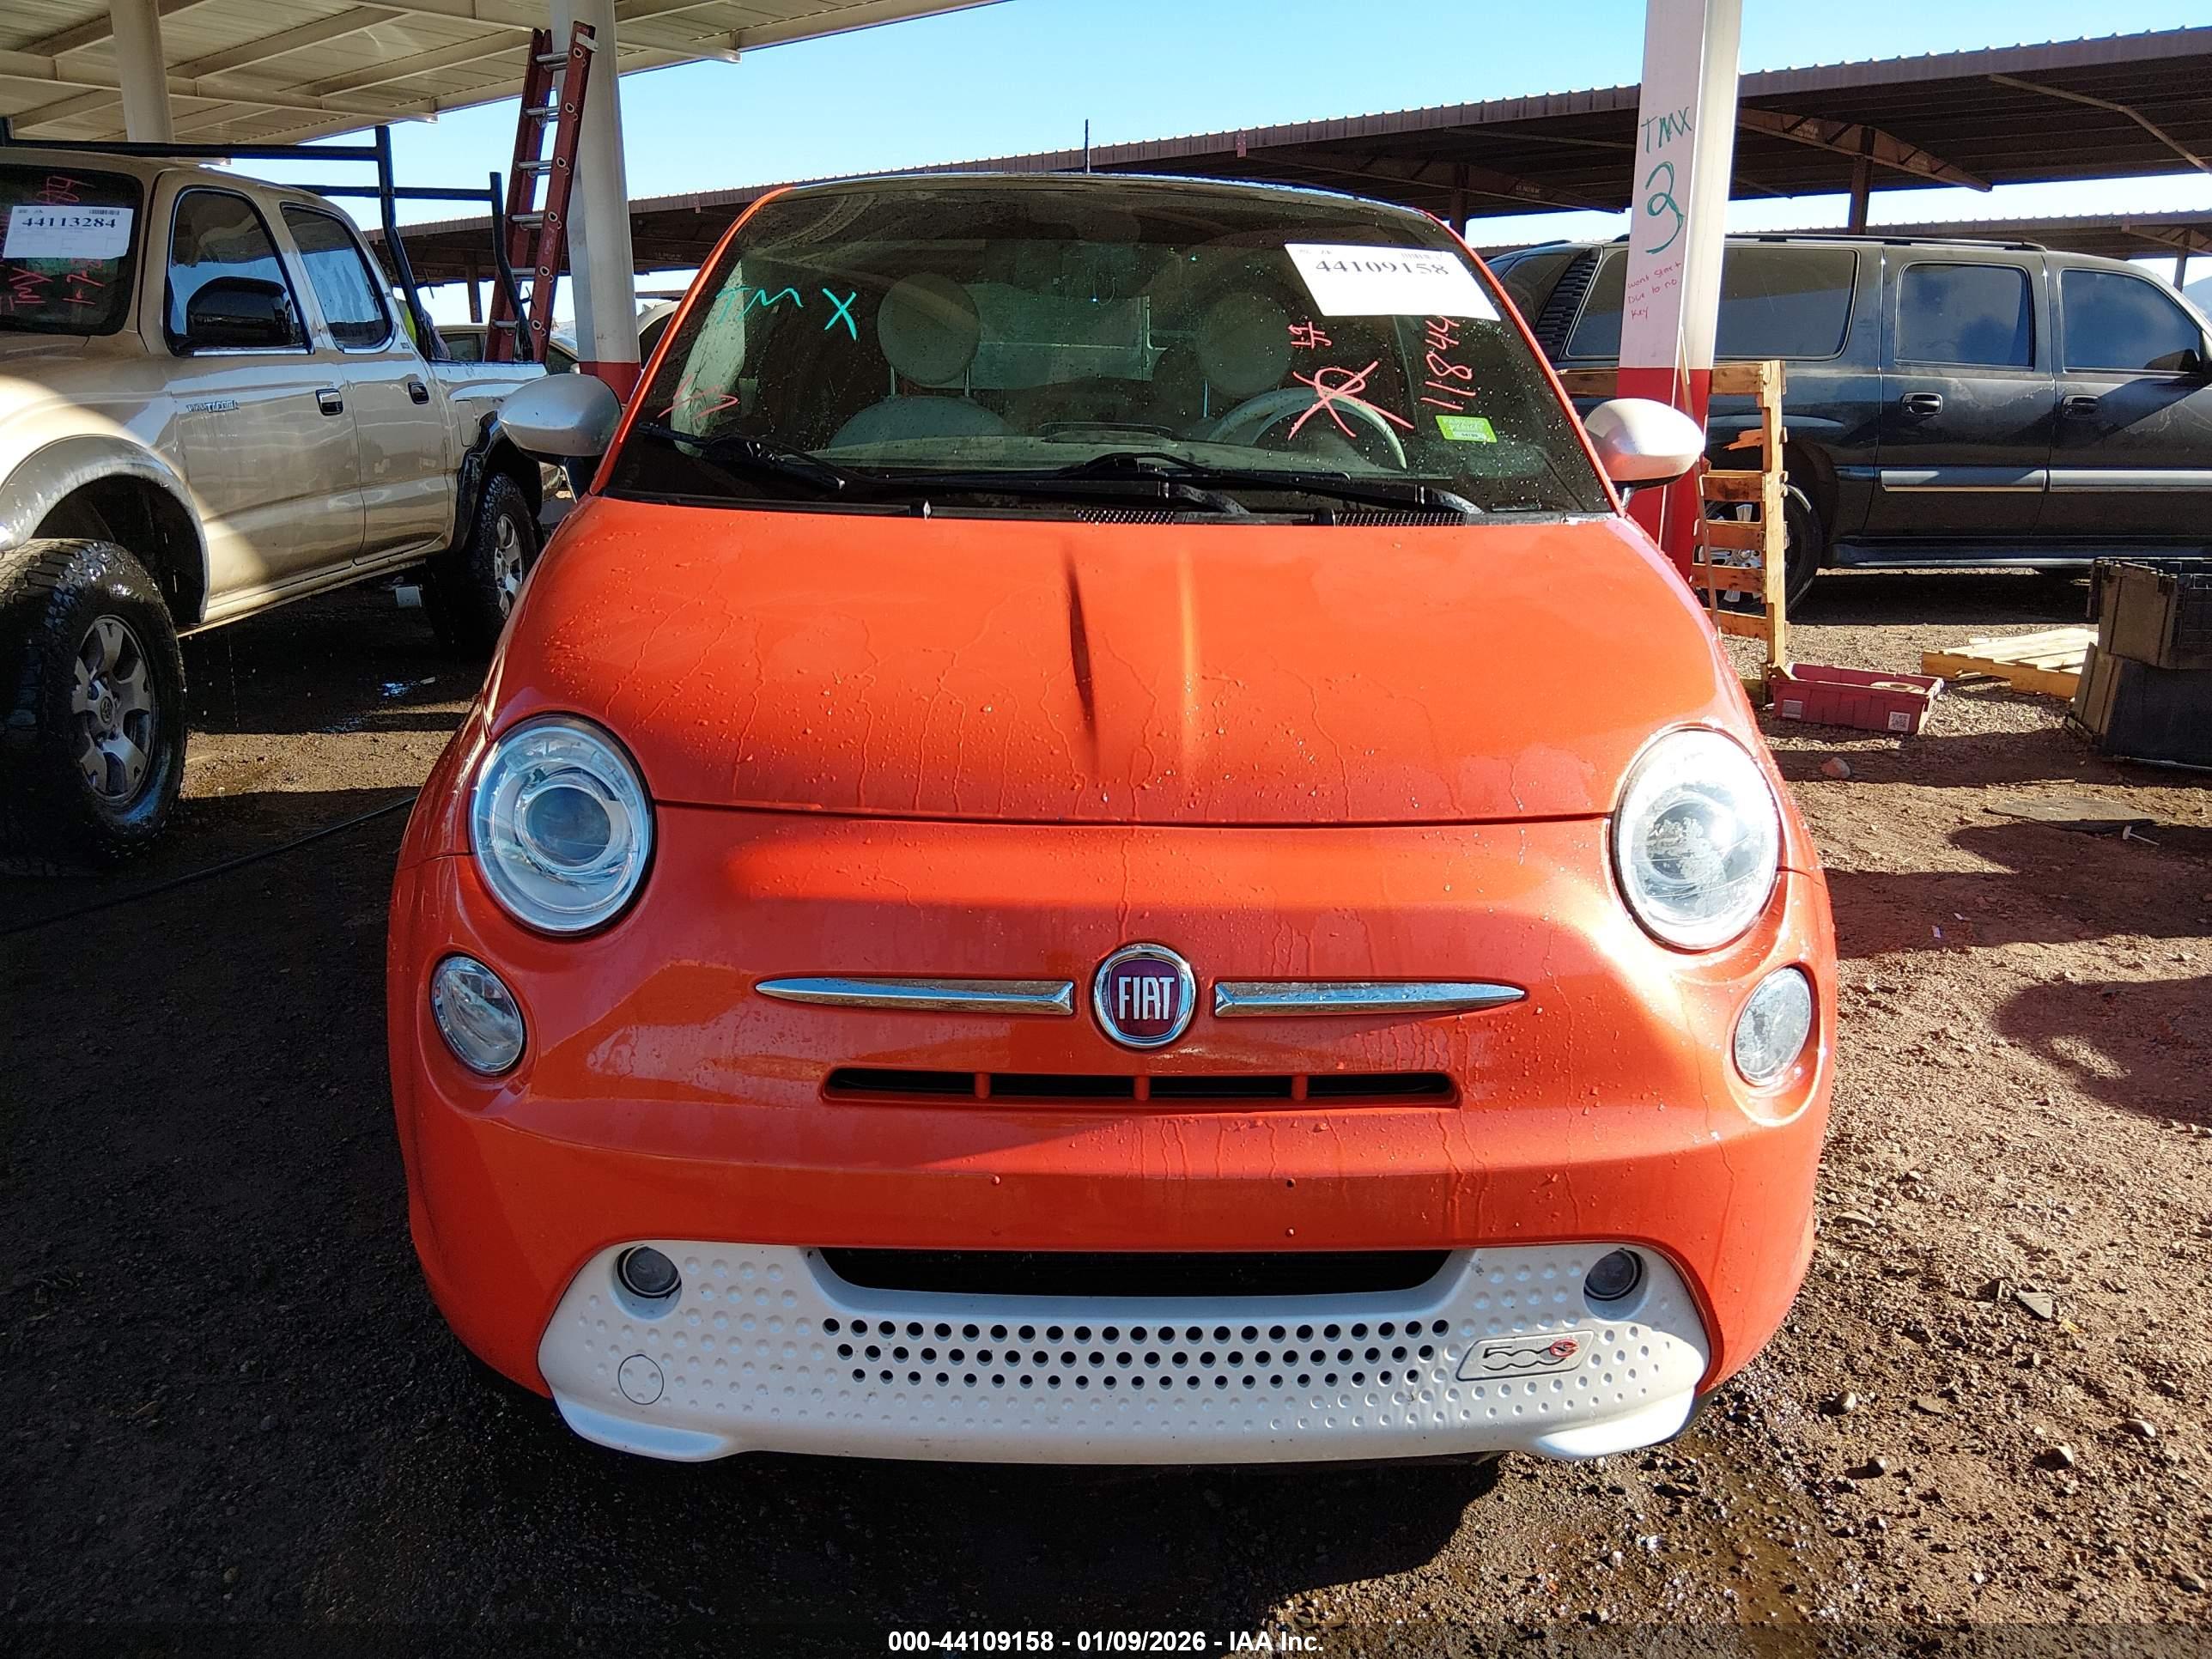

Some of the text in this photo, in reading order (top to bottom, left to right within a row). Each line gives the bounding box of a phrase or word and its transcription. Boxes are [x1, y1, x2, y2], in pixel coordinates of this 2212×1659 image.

[1640, 106, 1692, 154] TMX
[22, 217, 117, 228] 44113284
[1644, 161, 1685, 255] 3
[1316, 260, 1449, 275] 44109158
[1118, 976, 1176, 1020] FIAT
